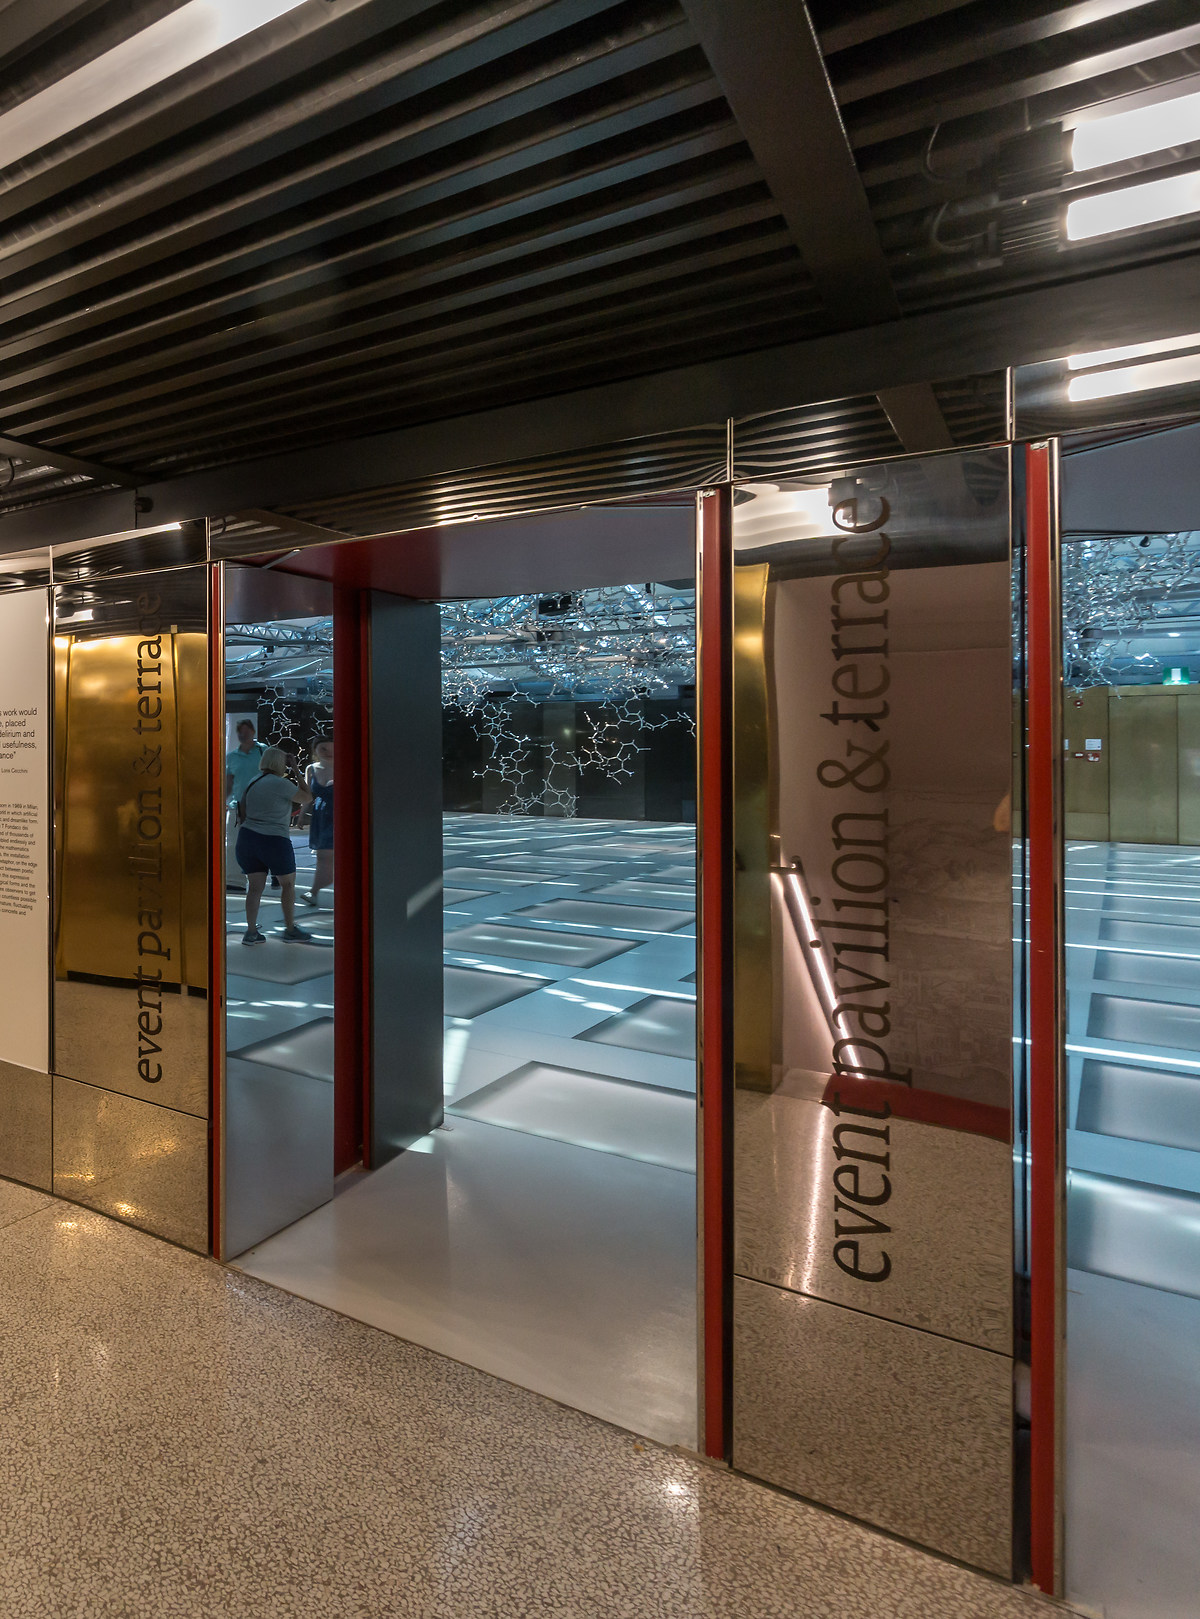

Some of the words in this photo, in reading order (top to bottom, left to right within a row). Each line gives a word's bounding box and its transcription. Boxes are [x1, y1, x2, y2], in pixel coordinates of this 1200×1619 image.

[134, 590, 163, 736] terrace
[819, 494, 891, 723] terrace
[133, 745, 163, 778] &
[817, 729, 890, 794] &
[128, 786, 171, 961] pavilion
[809, 808, 913, 1087] pavilion
[136, 965, 163, 1085] event
[829, 1093, 891, 1283] event
